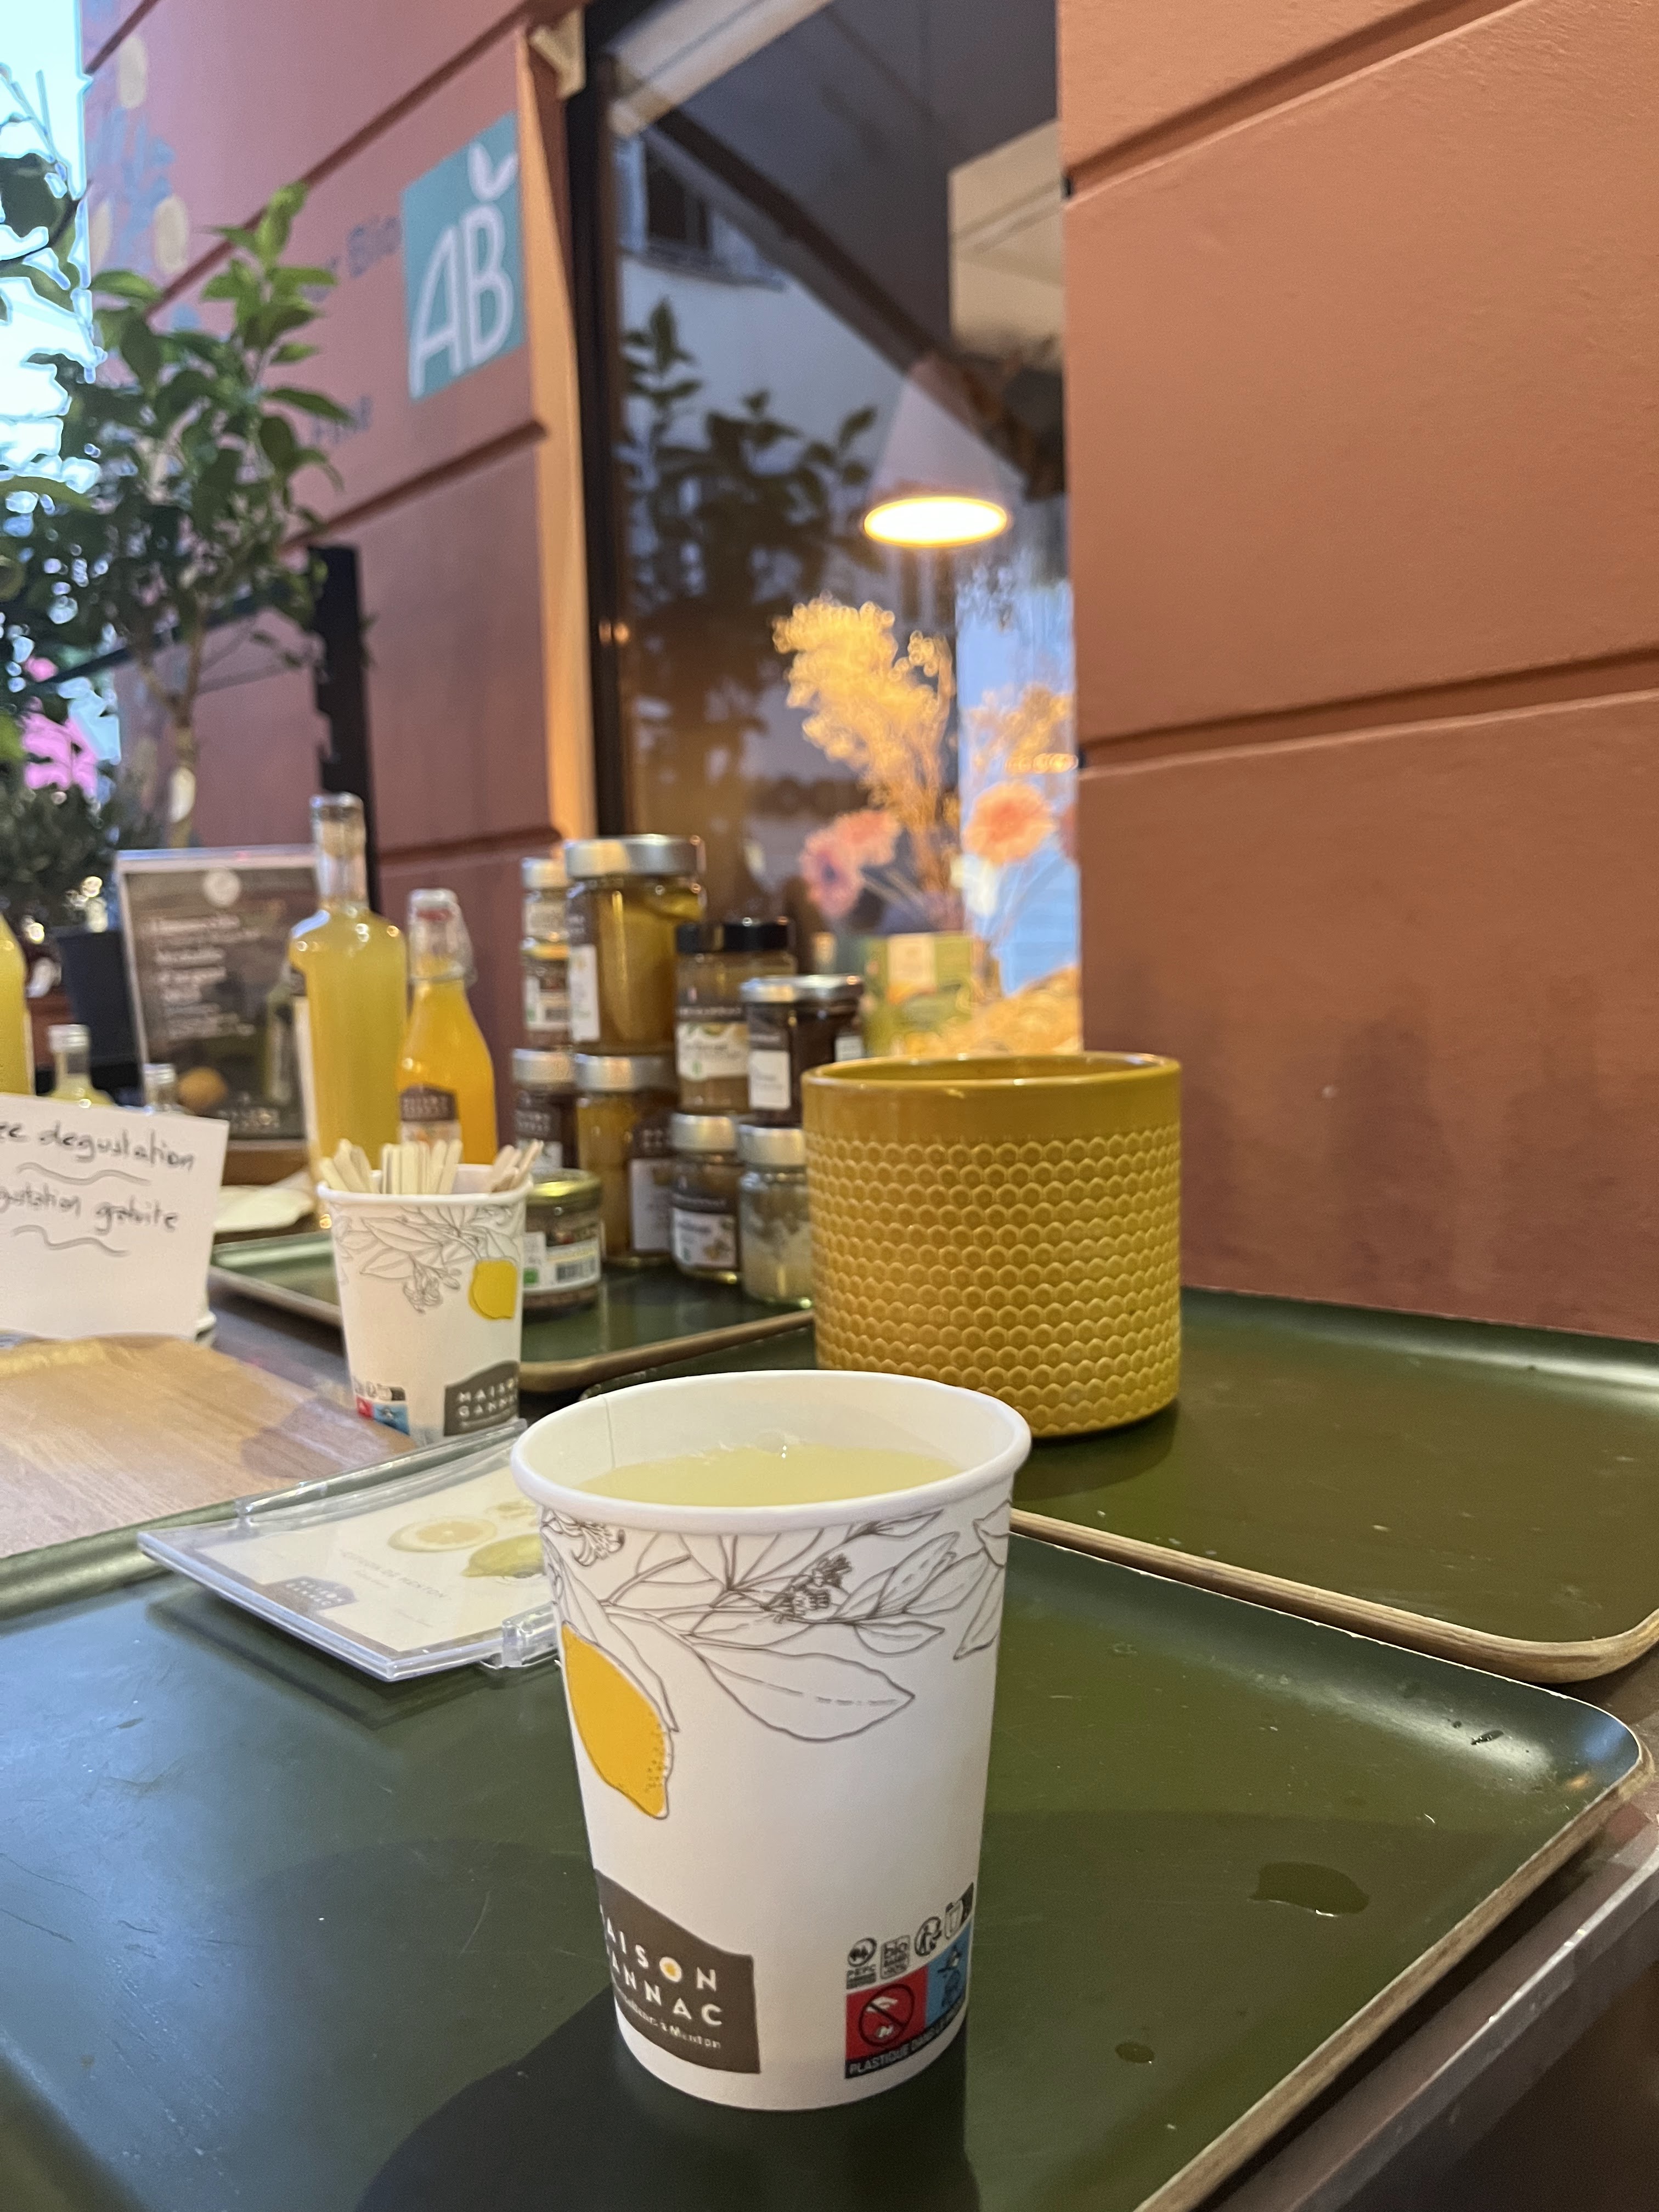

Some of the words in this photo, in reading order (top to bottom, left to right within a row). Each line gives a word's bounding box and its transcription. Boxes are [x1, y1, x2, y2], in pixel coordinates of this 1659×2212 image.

[408, 205, 515, 405] AB
[601, 1908, 717, 1993] AISON
[607, 1949, 723, 2026] ANNAC
